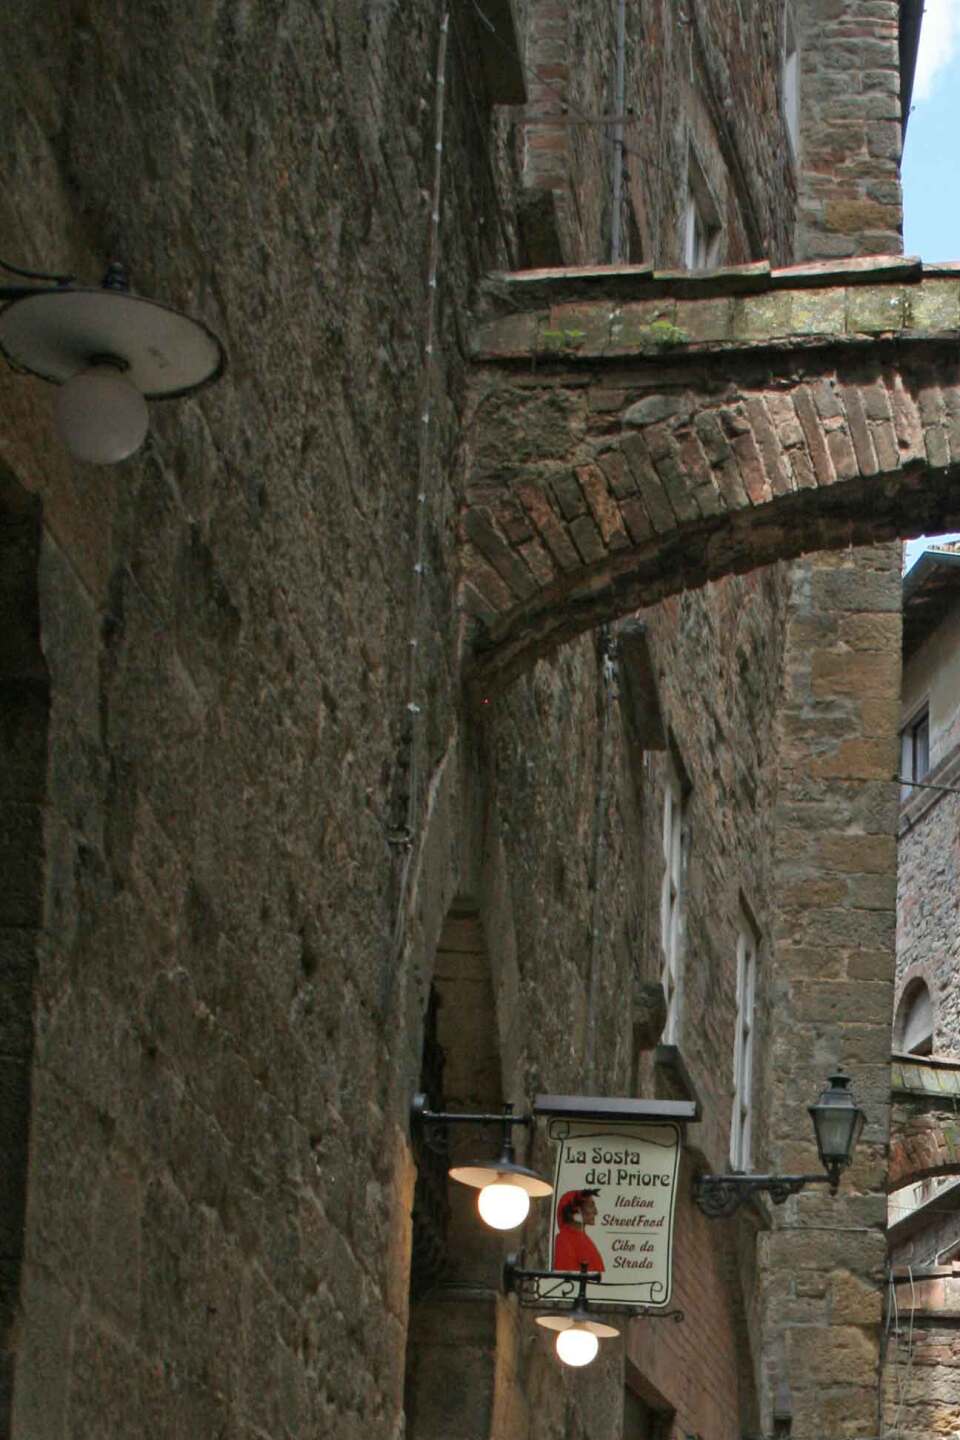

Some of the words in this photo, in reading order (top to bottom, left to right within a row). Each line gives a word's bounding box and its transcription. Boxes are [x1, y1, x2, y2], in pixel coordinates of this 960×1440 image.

[565, 1147, 586, 1164] La
[591, 1147, 641, 1165] Sosta
[585, 1168, 612, 1186] del
[616, 1169, 671, 1187] Priore
[615, 1195, 655, 1208] Italian
